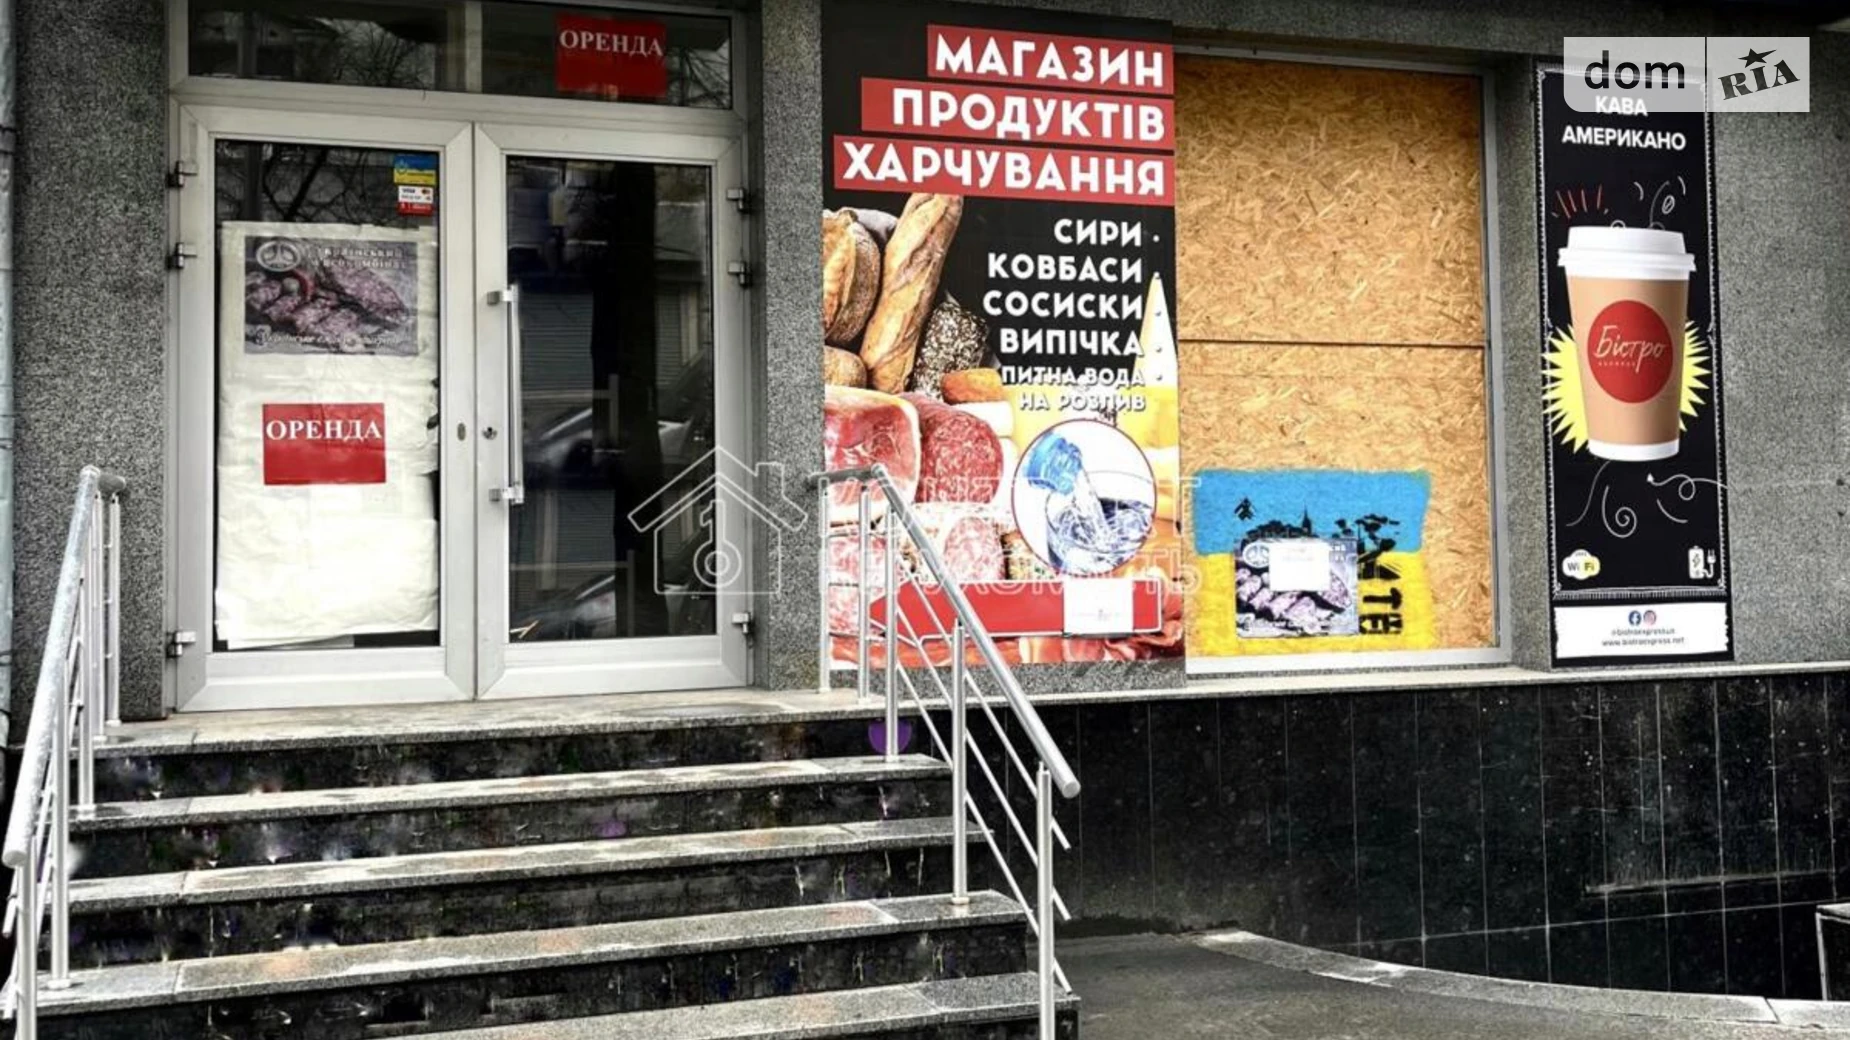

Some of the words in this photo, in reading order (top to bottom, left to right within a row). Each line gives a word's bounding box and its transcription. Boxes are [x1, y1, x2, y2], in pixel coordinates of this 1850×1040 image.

[560, 29, 663, 57] ОРЕНДА
[935, 33, 1164, 88] МАГАЗИН
[893, 88, 1165, 142] ПРОДУКТІВ
[1595, 96, 1648, 117] КАВА
[1562, 125, 1687, 150] АМЕРИКАНО
[843, 141, 1165, 197] ХАРЧУВАННЯ
[1054, 219, 1142, 247] СИРИ
[988, 253, 1143, 284] КОВБАСИ
[983, 290, 1143, 320] СОСИСКИ
[1000, 328, 1145, 357] ВИПІЧКА
[1002, 366, 1077, 386] ПИТНА
[1084, 368, 1146, 389] ВОДА
[1020, 393, 1050, 411] НА
[266, 419, 382, 442] ОРЕНДА
